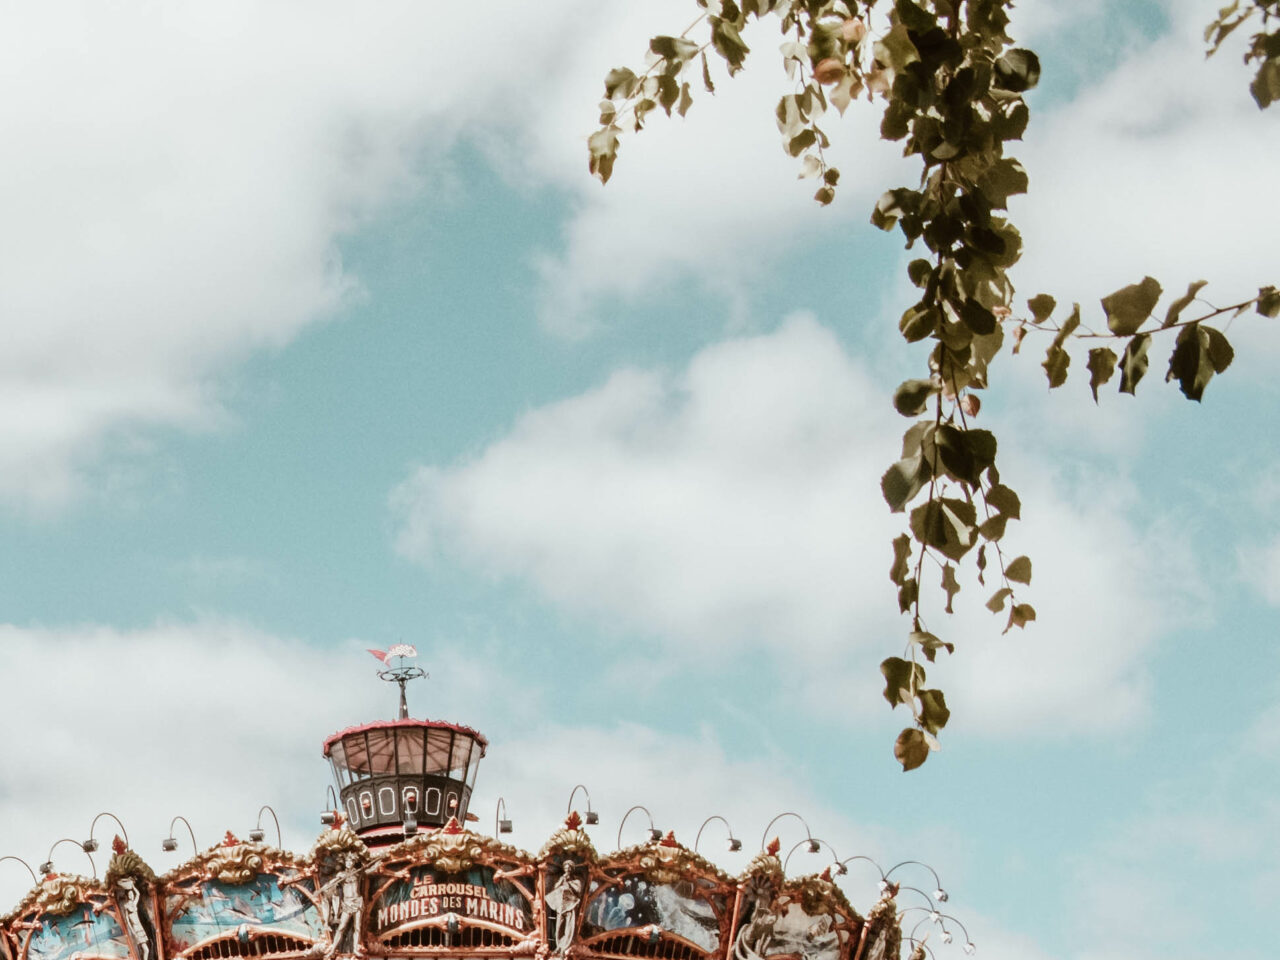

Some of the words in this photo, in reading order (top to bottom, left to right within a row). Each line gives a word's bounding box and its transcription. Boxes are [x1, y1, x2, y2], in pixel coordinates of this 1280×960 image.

[413, 874, 433, 886] LE
[410, 883, 491, 899] CARROUSEL
[377, 897, 439, 930] MONDES
[442, 896, 462, 908] DES
[466, 897, 524, 930] MARINS
